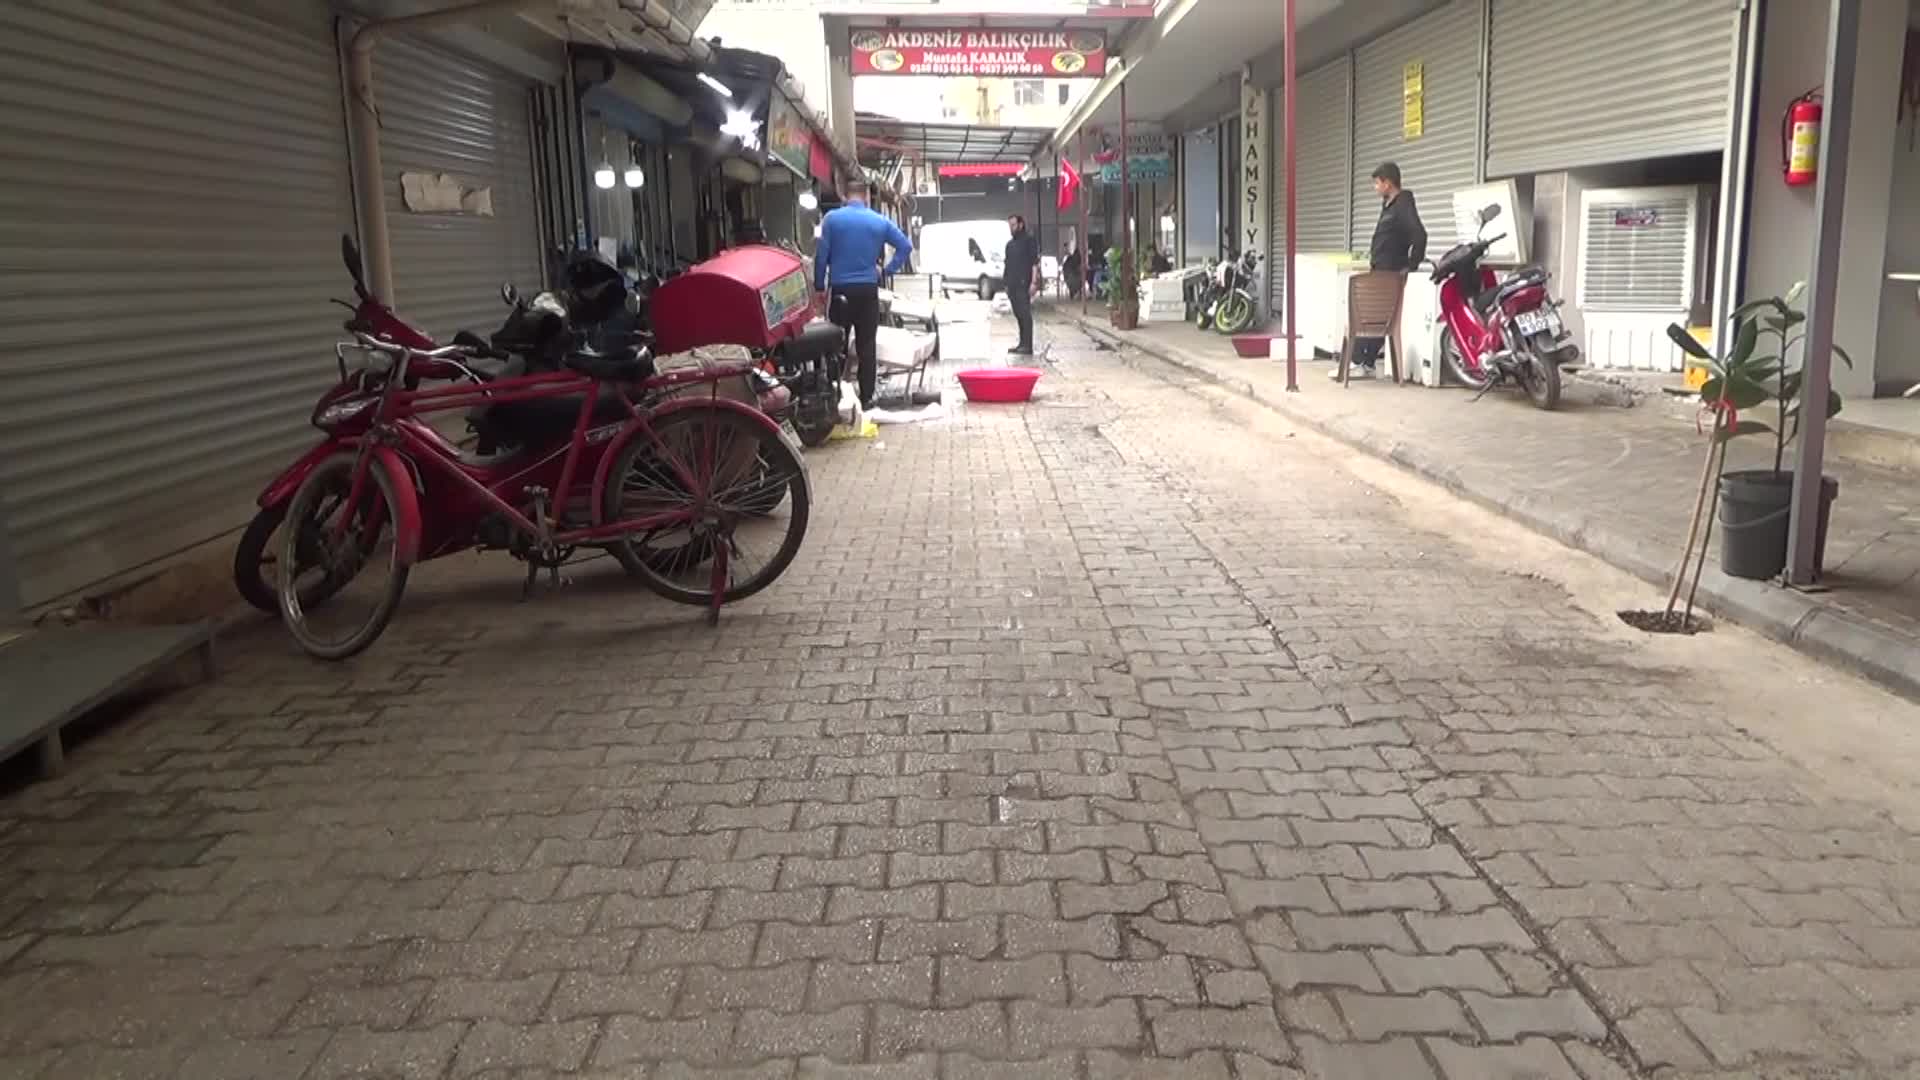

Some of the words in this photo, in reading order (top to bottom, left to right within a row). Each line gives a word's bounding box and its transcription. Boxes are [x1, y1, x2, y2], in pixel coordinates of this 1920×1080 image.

[885, 29, 962, 47] AKDENİZ
[967, 32, 1067, 52] BALIKÇILIK
[923, 52, 968, 64] Mustafa
[970, 52, 1026, 64] KARALIK
